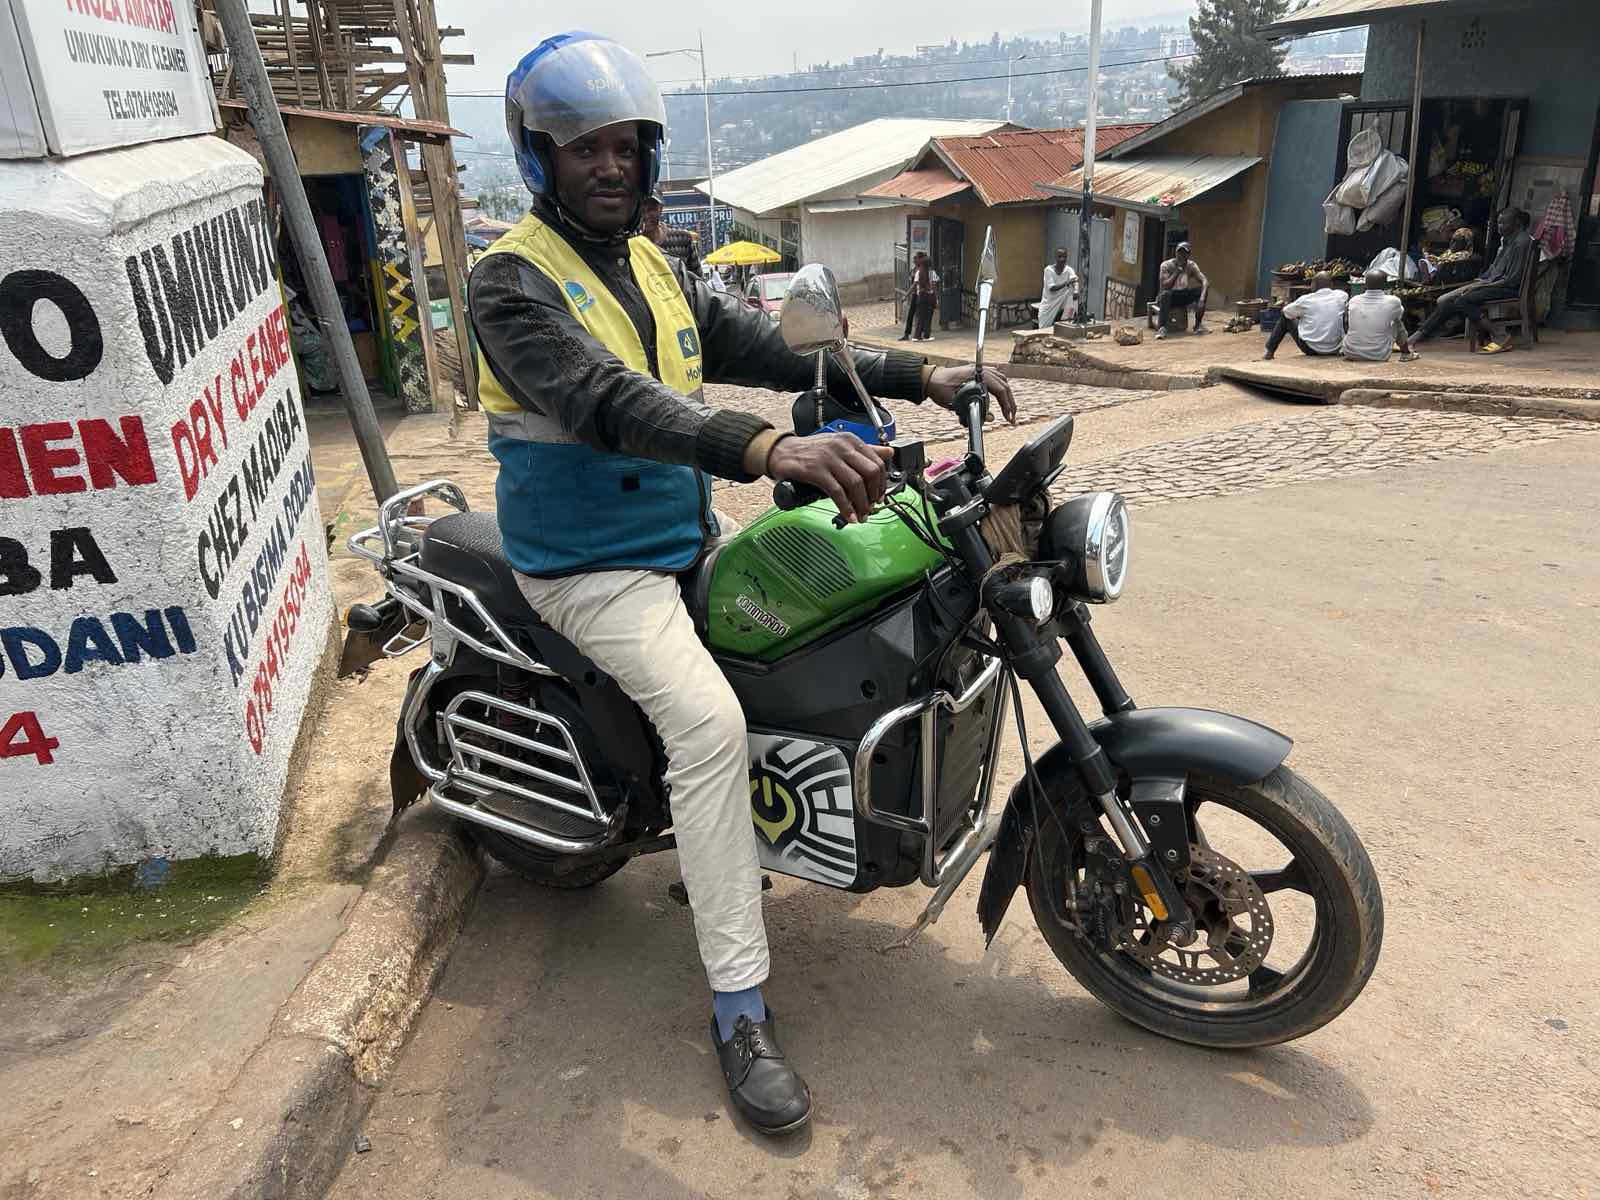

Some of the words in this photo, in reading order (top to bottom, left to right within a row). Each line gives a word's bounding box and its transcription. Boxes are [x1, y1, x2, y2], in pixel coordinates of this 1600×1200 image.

[64, 28, 132, 68] UMUKUNJO
[131, 41, 152, 69] DRY
[151, 44, 189, 72] CLEANER
[0, 269, 104, 383] O
[171, 374, 228, 503] DRY
[198, 474, 249, 600] CHEZ
[242, 387, 302, 522] MADIBA
[0, 526, 119, 596] BA
[224, 514, 288, 688] KUBISIMA
[0, 605, 197, 684] DANI
[246, 540, 313, 756] 0784195094
[0, 711, 60, 766] 4
